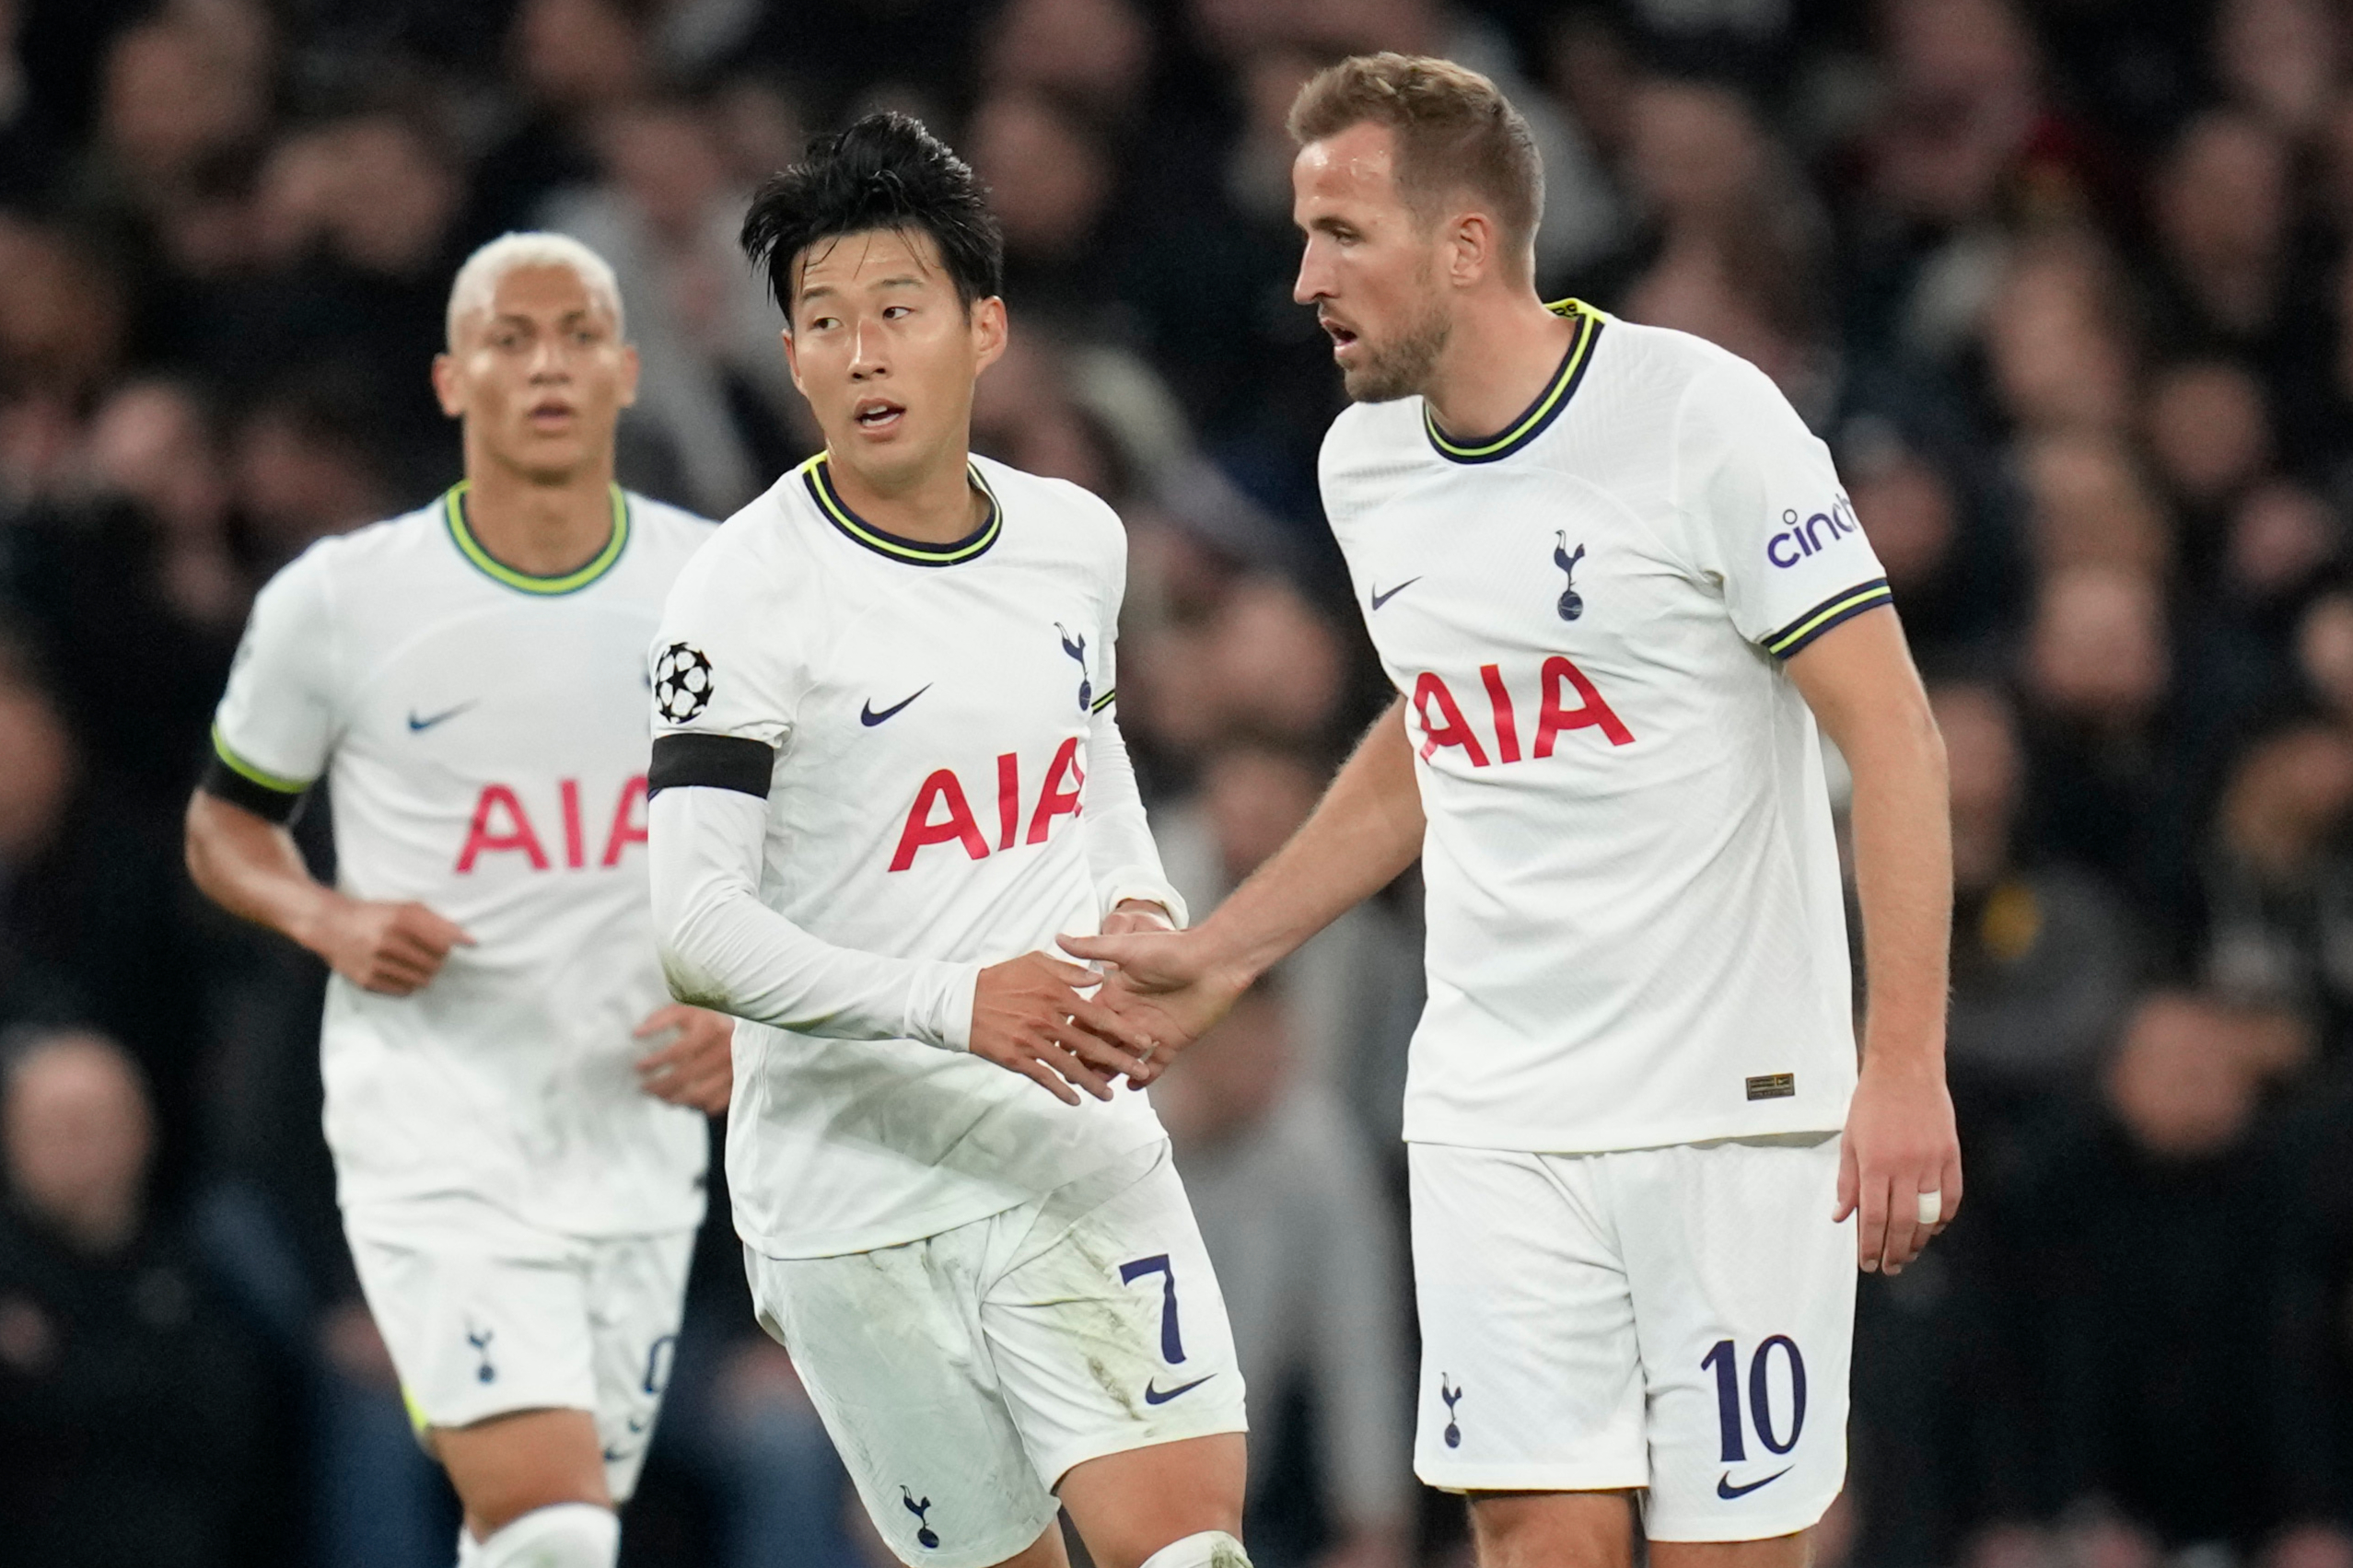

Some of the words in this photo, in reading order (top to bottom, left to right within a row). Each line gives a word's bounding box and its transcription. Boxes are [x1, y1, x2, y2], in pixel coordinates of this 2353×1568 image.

[1414, 656, 1636, 767] AIA
[888, 737, 1085, 872] AIA
[1119, 1253, 1187, 1365] 7
[1701, 1334, 1807, 1461] 10
